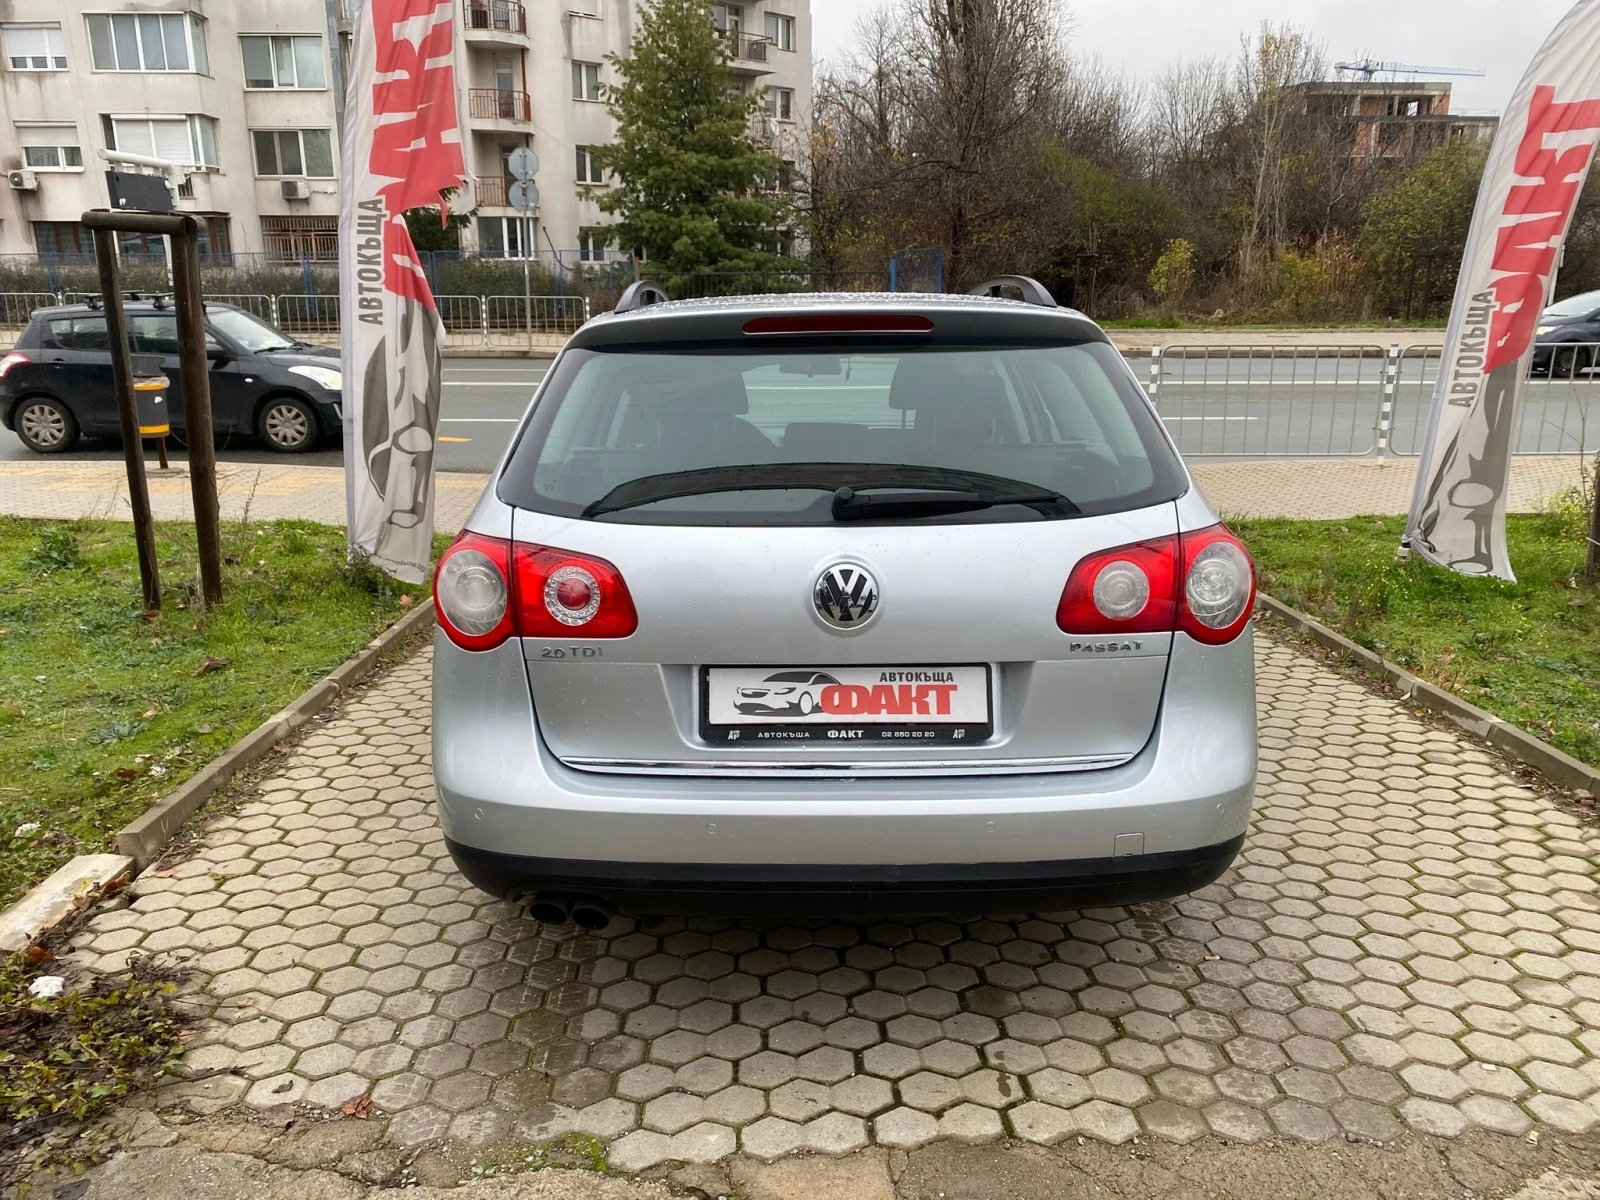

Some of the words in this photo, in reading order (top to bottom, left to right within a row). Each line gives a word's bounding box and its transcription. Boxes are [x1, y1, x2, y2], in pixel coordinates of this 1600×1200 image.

[358, 198, 388, 326] АВТОКЪЩА
[1448, 288, 1497, 409] АВТОКЪЩА
[569, 645, 603, 657] TDI
[1069, 639, 1144, 653] PASSAT
[879, 671, 954, 684] АВТОКЪЩА
[820, 684, 957, 715] ФАКТ
[827, 730, 864, 739] ФАКТ
